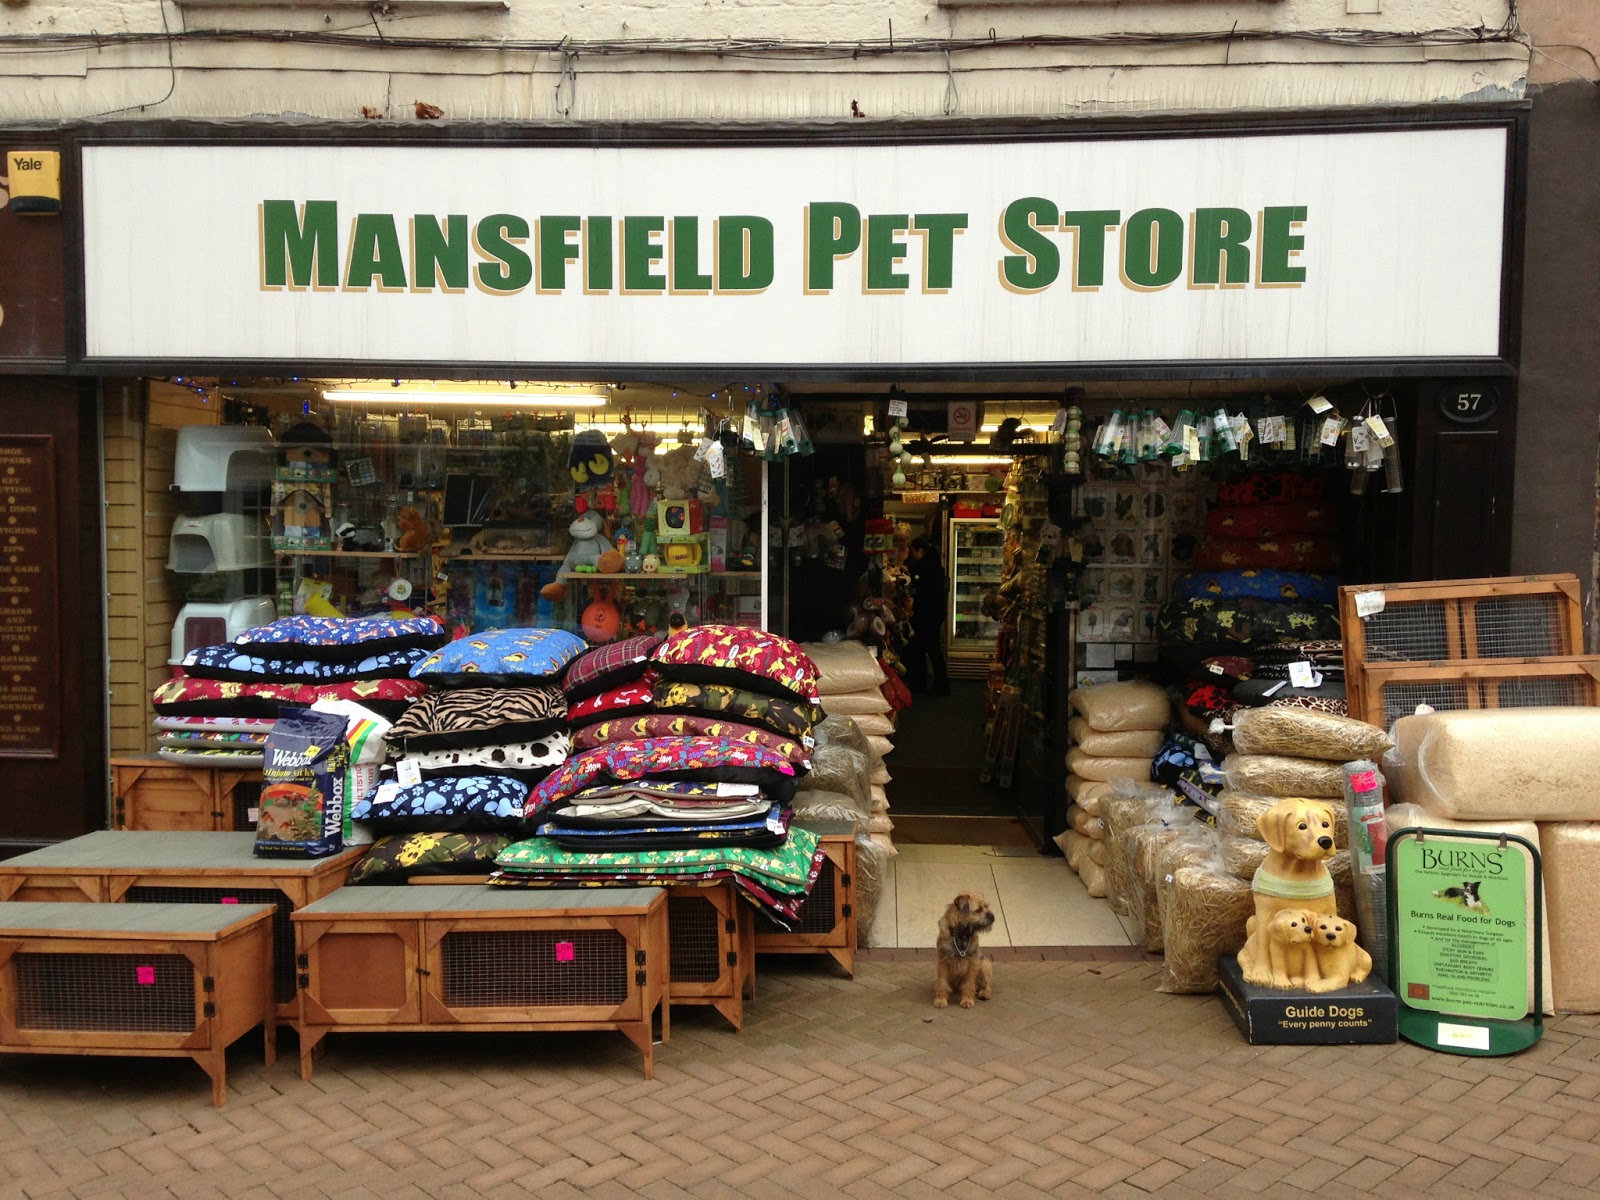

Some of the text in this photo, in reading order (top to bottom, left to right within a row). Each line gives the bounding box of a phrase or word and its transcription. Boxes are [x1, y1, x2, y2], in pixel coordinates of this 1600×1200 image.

[14, 158, 42, 170] Yale
[1457, 393, 1482, 411] 57
[325, 777, 343, 838] Webbox
[391, 793, 409, 809] FIDO
[466, 795, 482, 810] FIDO
[1421, 848, 1503, 875] BURNS
[1410, 910, 1516, 927] Burns Real Food for Dogs
[1285, 1005, 1364, 1019] Guide Dogs
[1309, 1020, 1336, 1030] penny
